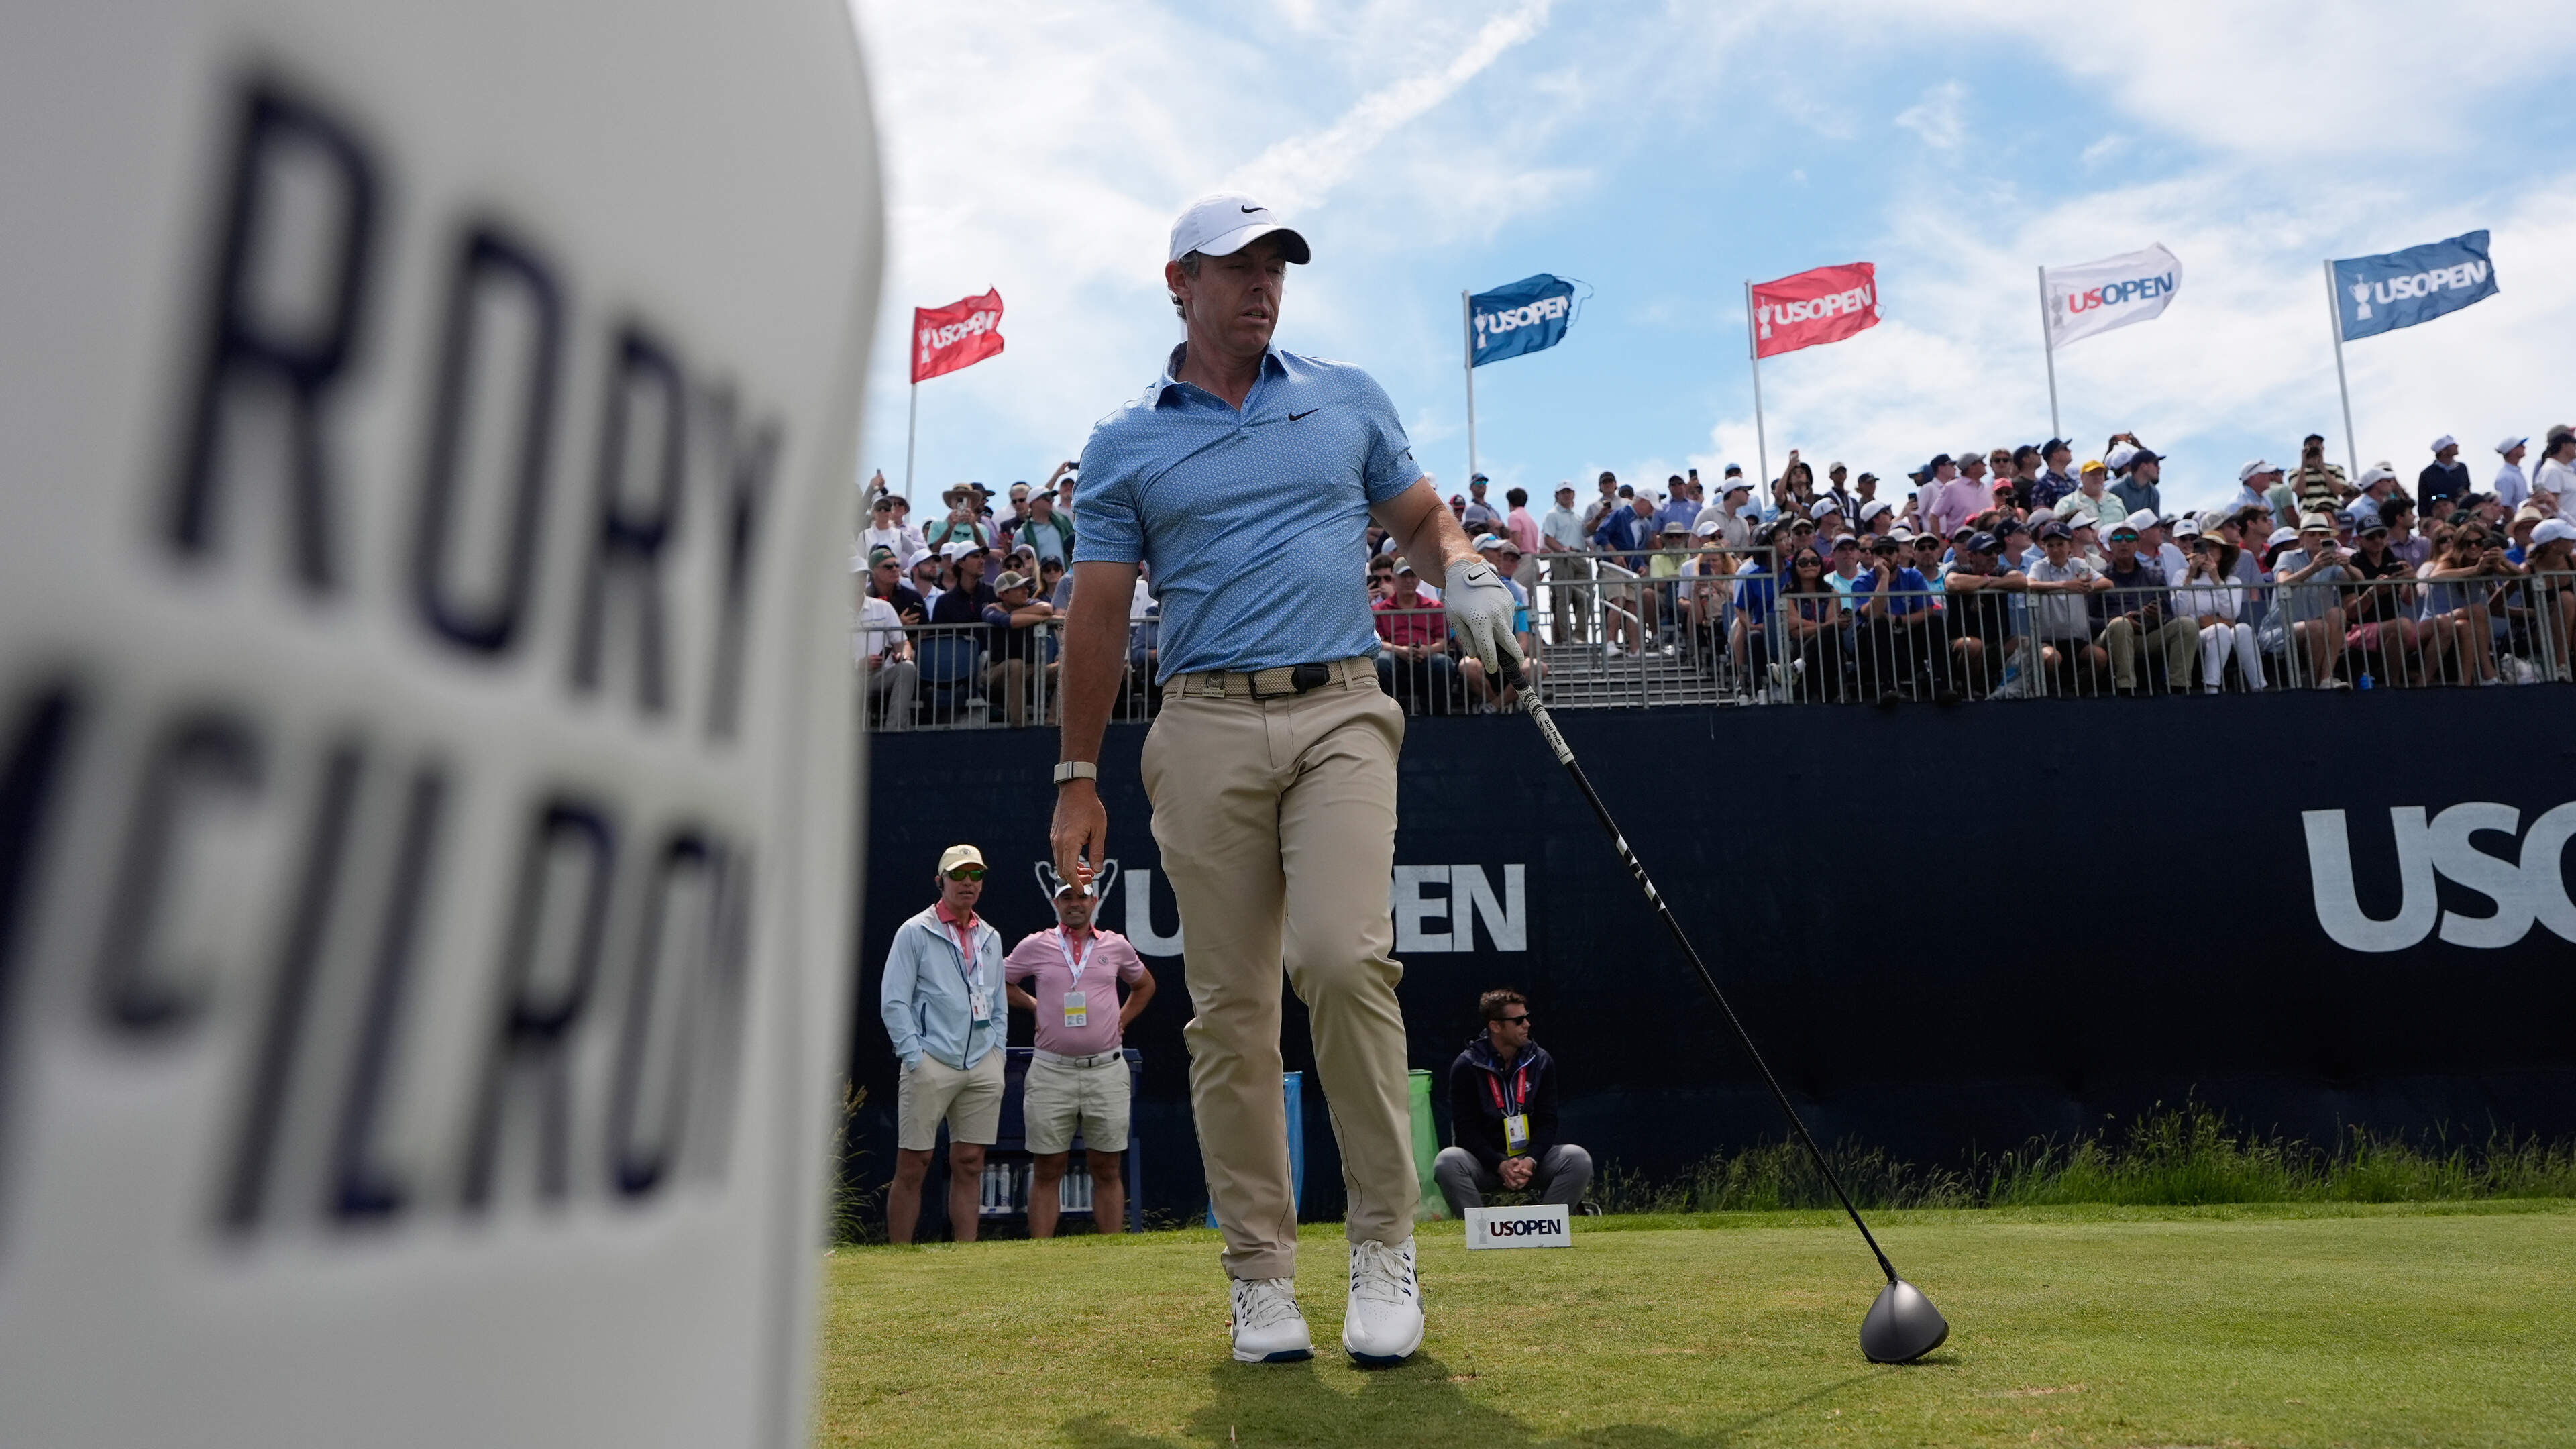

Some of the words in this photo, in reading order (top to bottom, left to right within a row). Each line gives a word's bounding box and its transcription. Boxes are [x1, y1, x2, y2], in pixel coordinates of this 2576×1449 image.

[144, 50, 785, 741] RORY
[1544, 719, 1554, 731] Golf
[1551, 731, 1562, 745] Pride
